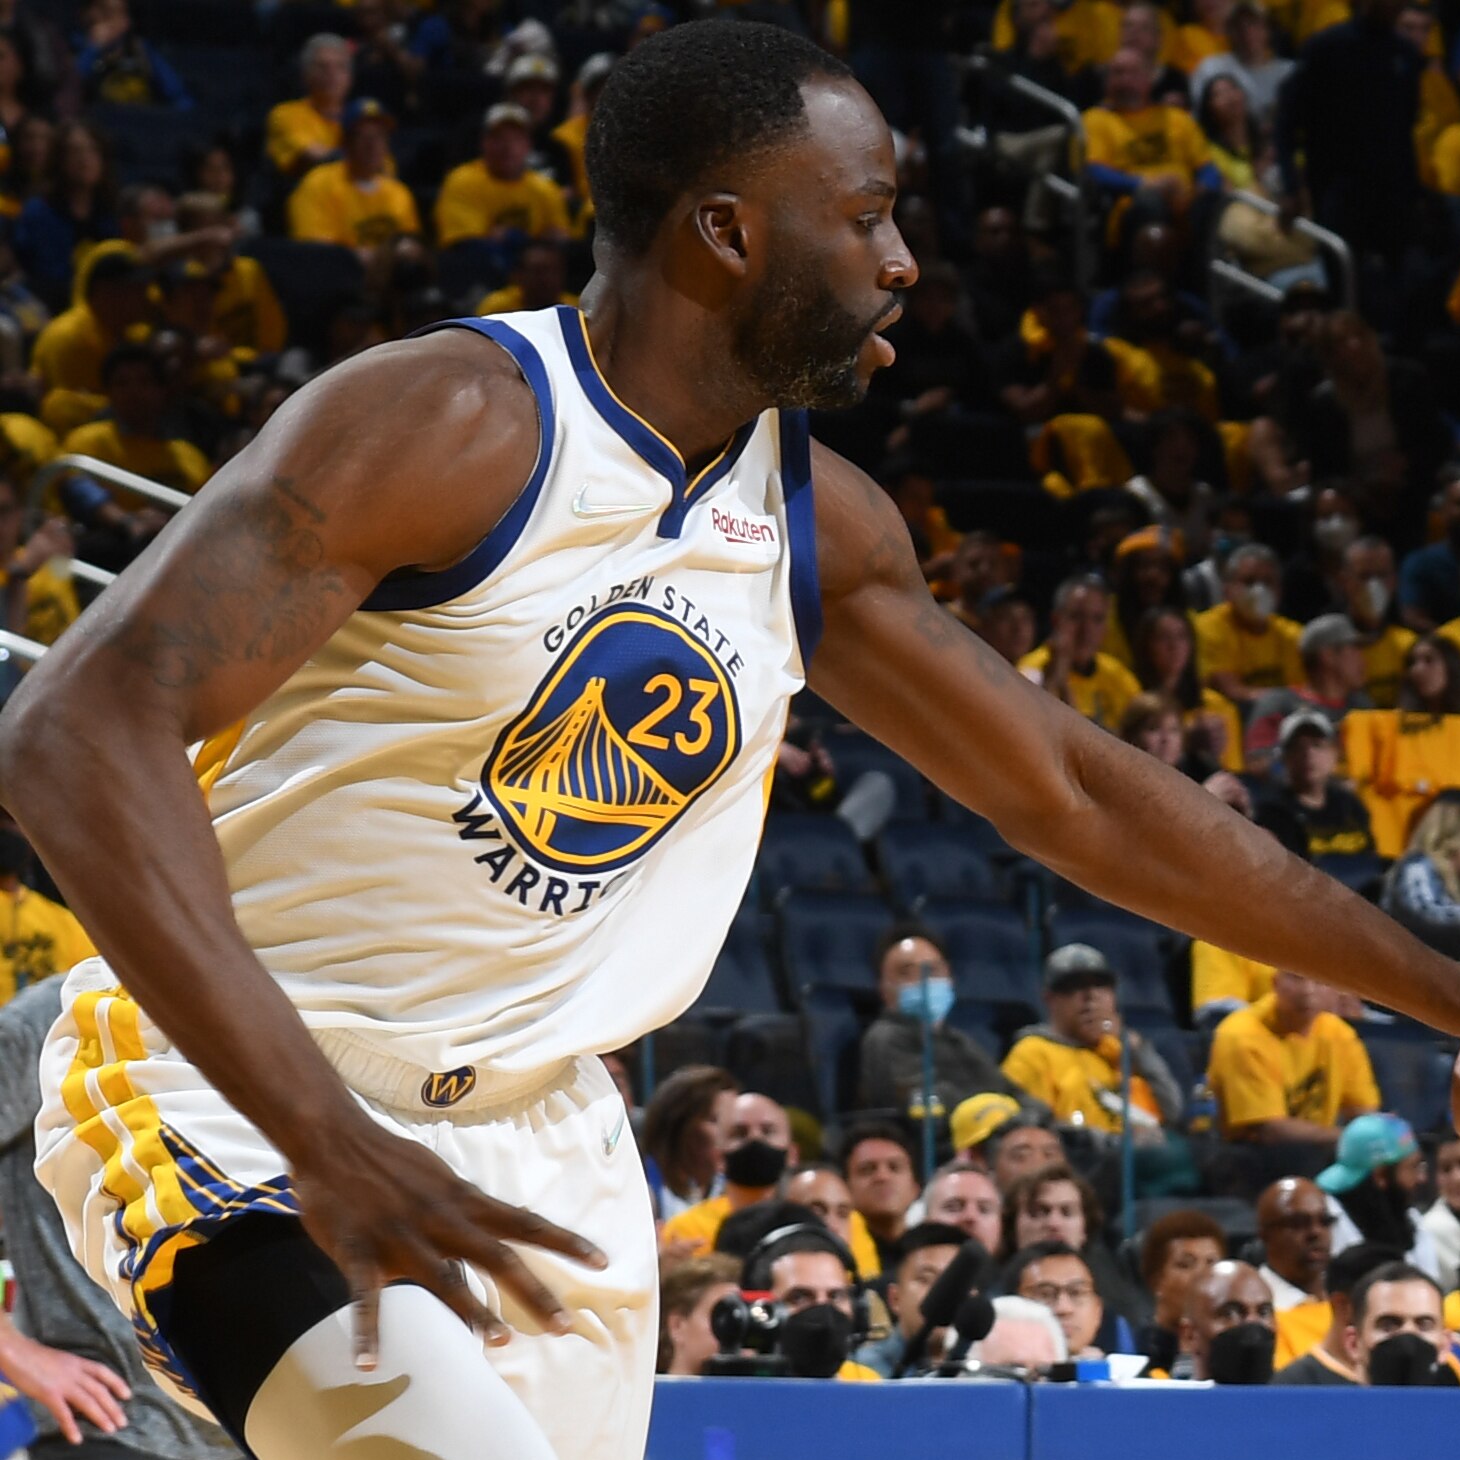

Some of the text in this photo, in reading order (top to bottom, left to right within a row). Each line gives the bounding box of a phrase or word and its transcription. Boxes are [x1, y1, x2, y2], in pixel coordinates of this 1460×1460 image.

[711, 507, 775, 543] Rakuten
[543, 576, 746, 678] GOLDEN STATE
[626, 673, 720, 756] 23
[451, 789, 629, 917] WARRI
[430, 1074, 474, 1102] W
